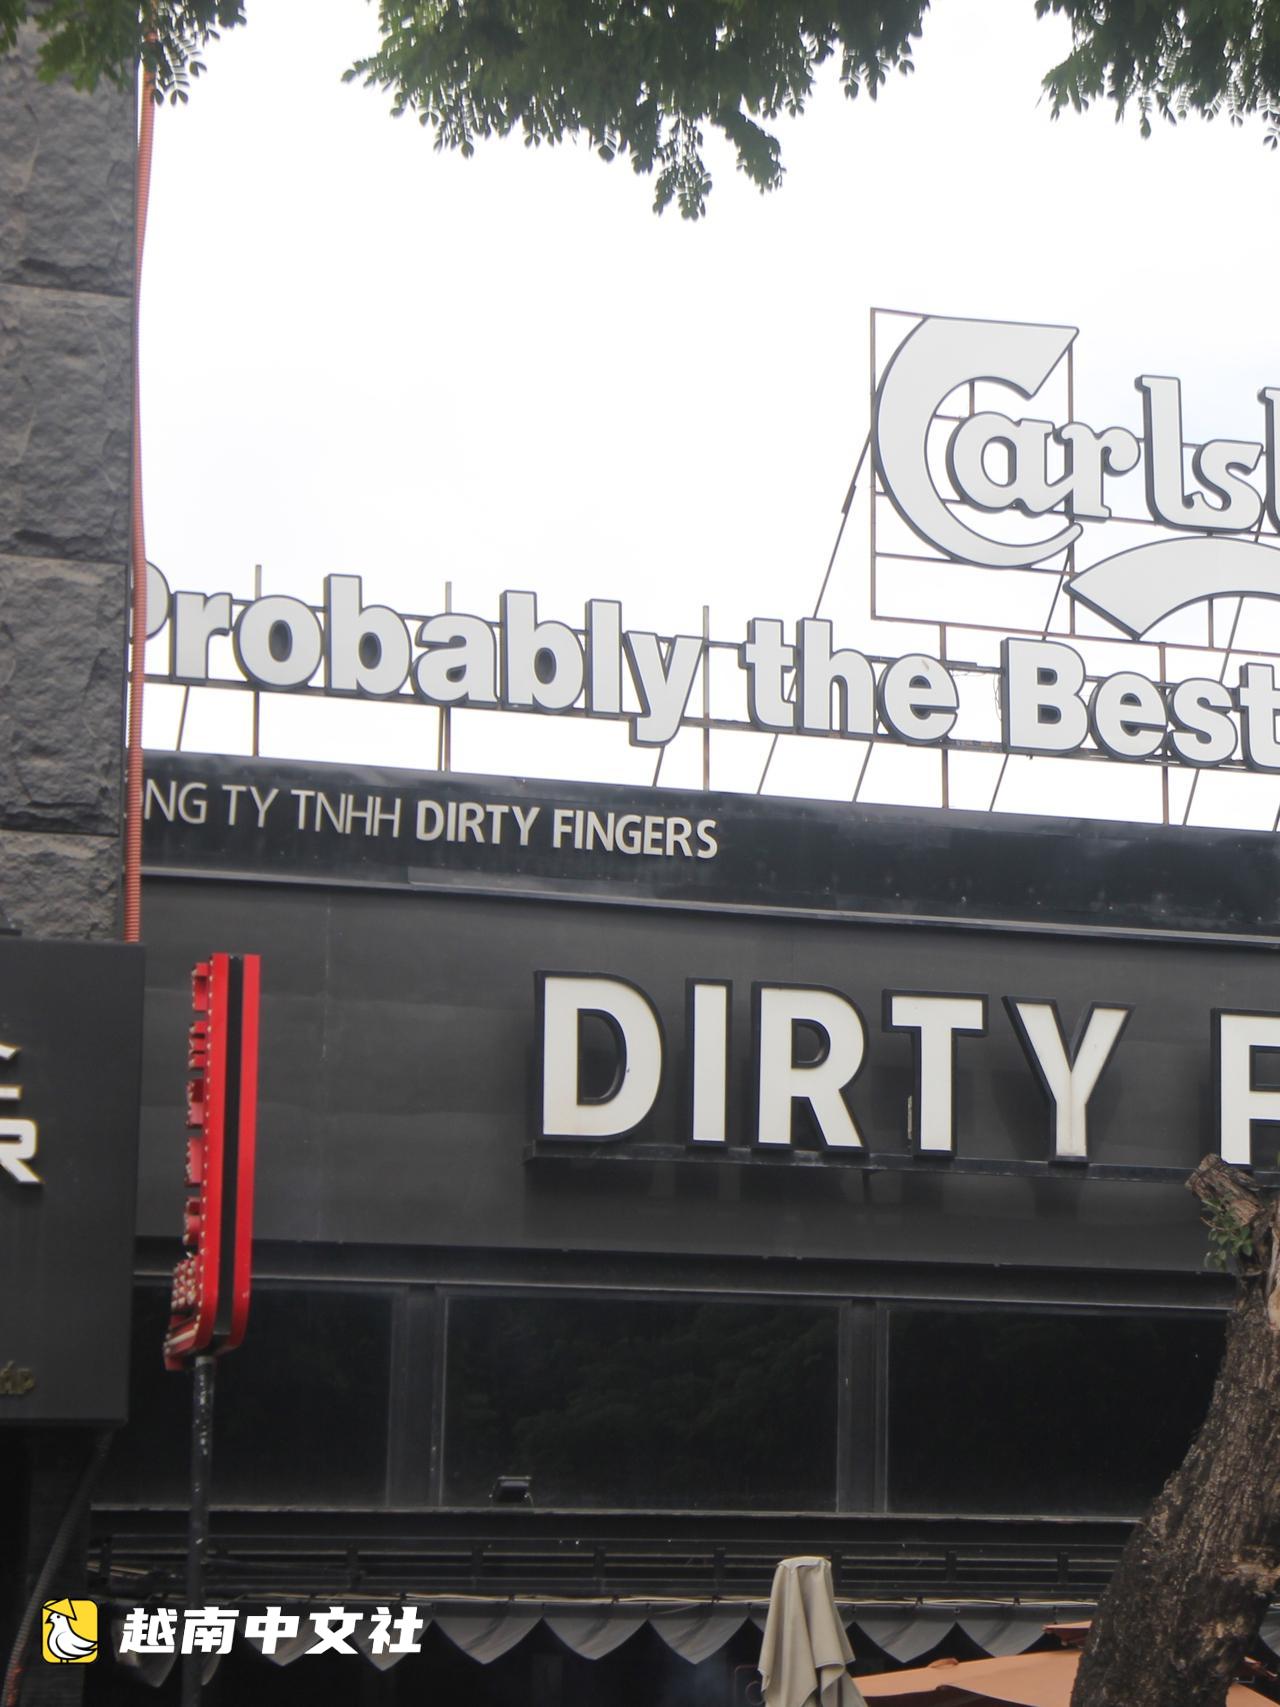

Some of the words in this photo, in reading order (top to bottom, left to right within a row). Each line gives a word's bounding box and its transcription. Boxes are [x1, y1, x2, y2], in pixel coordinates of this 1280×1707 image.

[740, 616, 961, 745] the
[141, 778, 207, 825] NG
[221, 784, 280, 829] TY
[290, 788, 402, 839] TNHH
[415, 800, 541, 847] DIRTY
[552, 808, 719, 860] FINGERS
[535, 970, 1134, 1164] DIRTY
